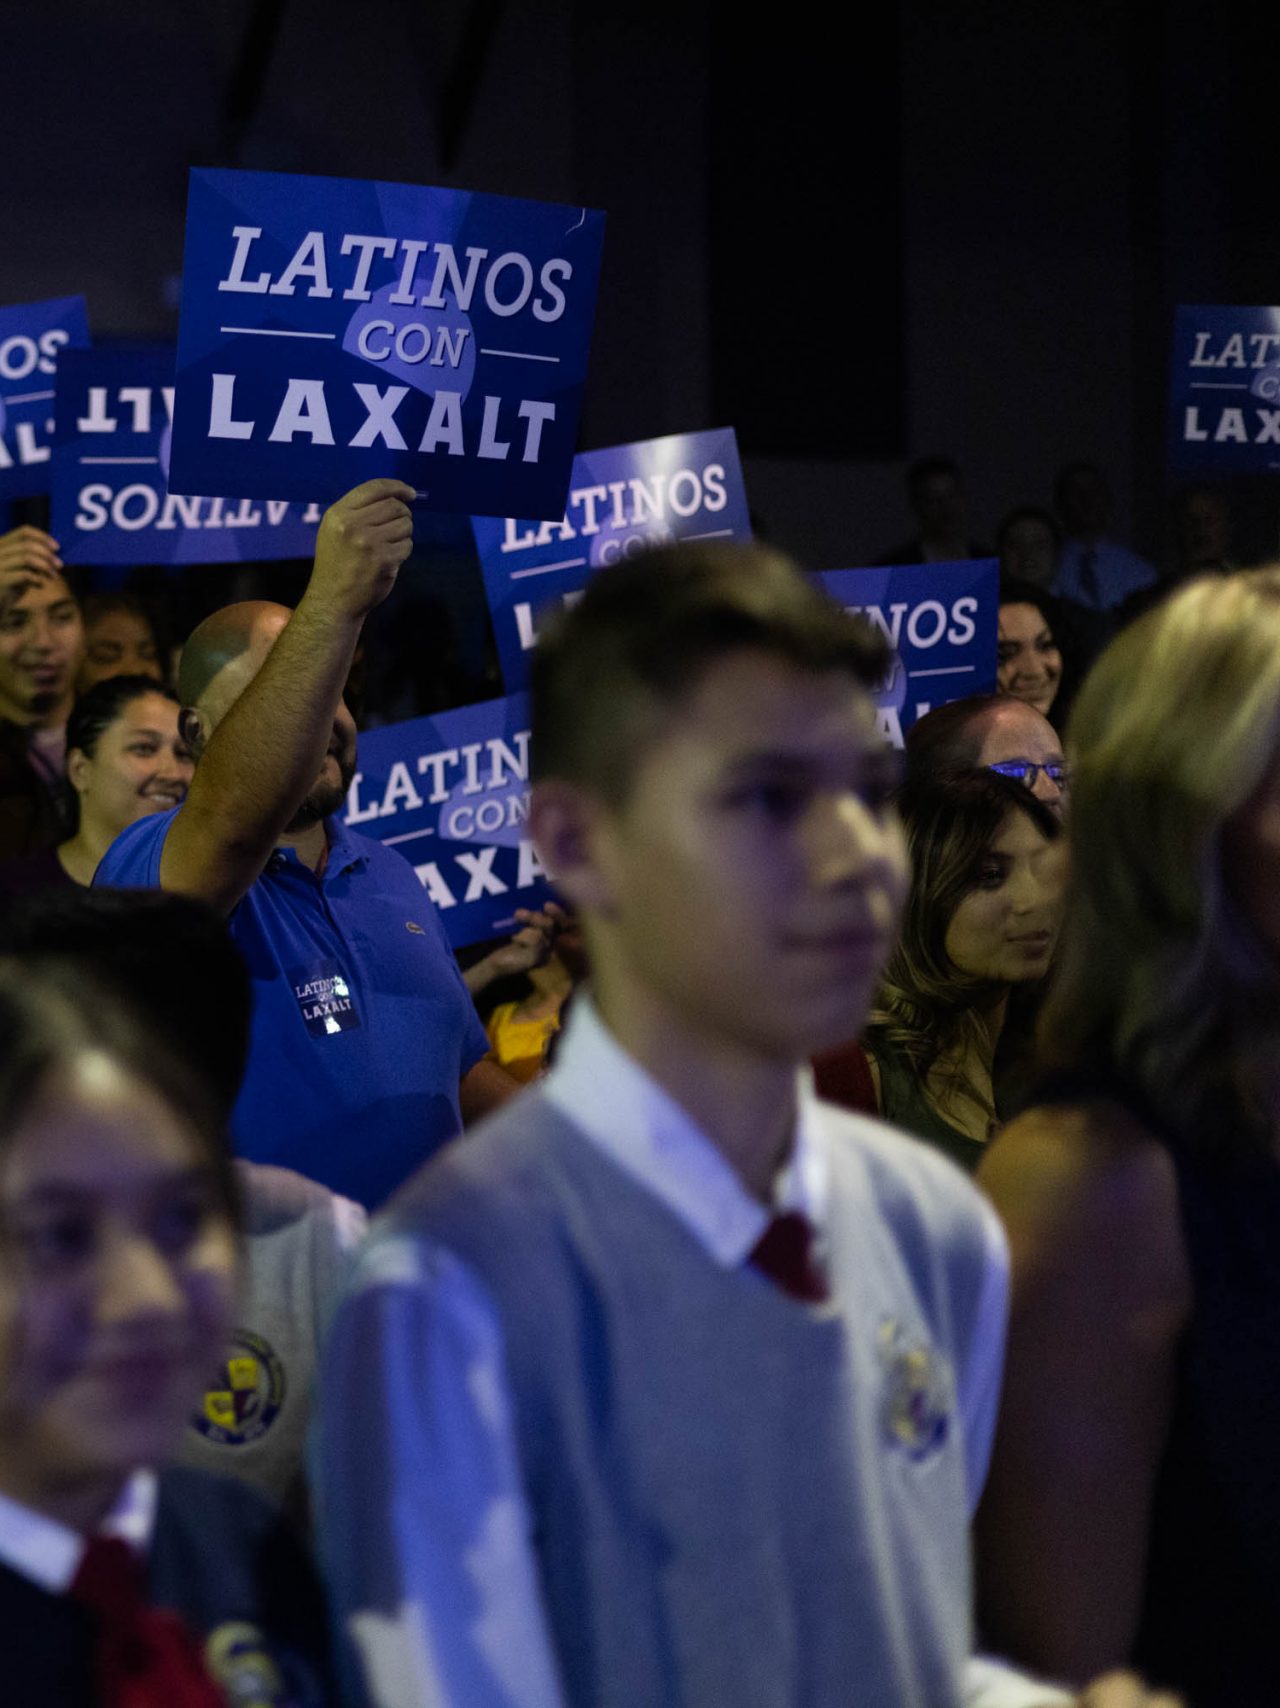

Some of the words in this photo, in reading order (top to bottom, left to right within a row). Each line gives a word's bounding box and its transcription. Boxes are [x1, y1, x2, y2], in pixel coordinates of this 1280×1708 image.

[217, 226, 573, 323] LATINOS
[358, 320, 469, 368] CON
[1189, 331, 1280, 369] LAT
[207, 373, 556, 464] LAXALT
[500, 463, 728, 554] LATINOS
[844, 595, 979, 650] NOS
[344, 730, 533, 826] LATIN
[414, 838, 552, 910] AXA
[303, 998, 352, 1020] LAXALT
